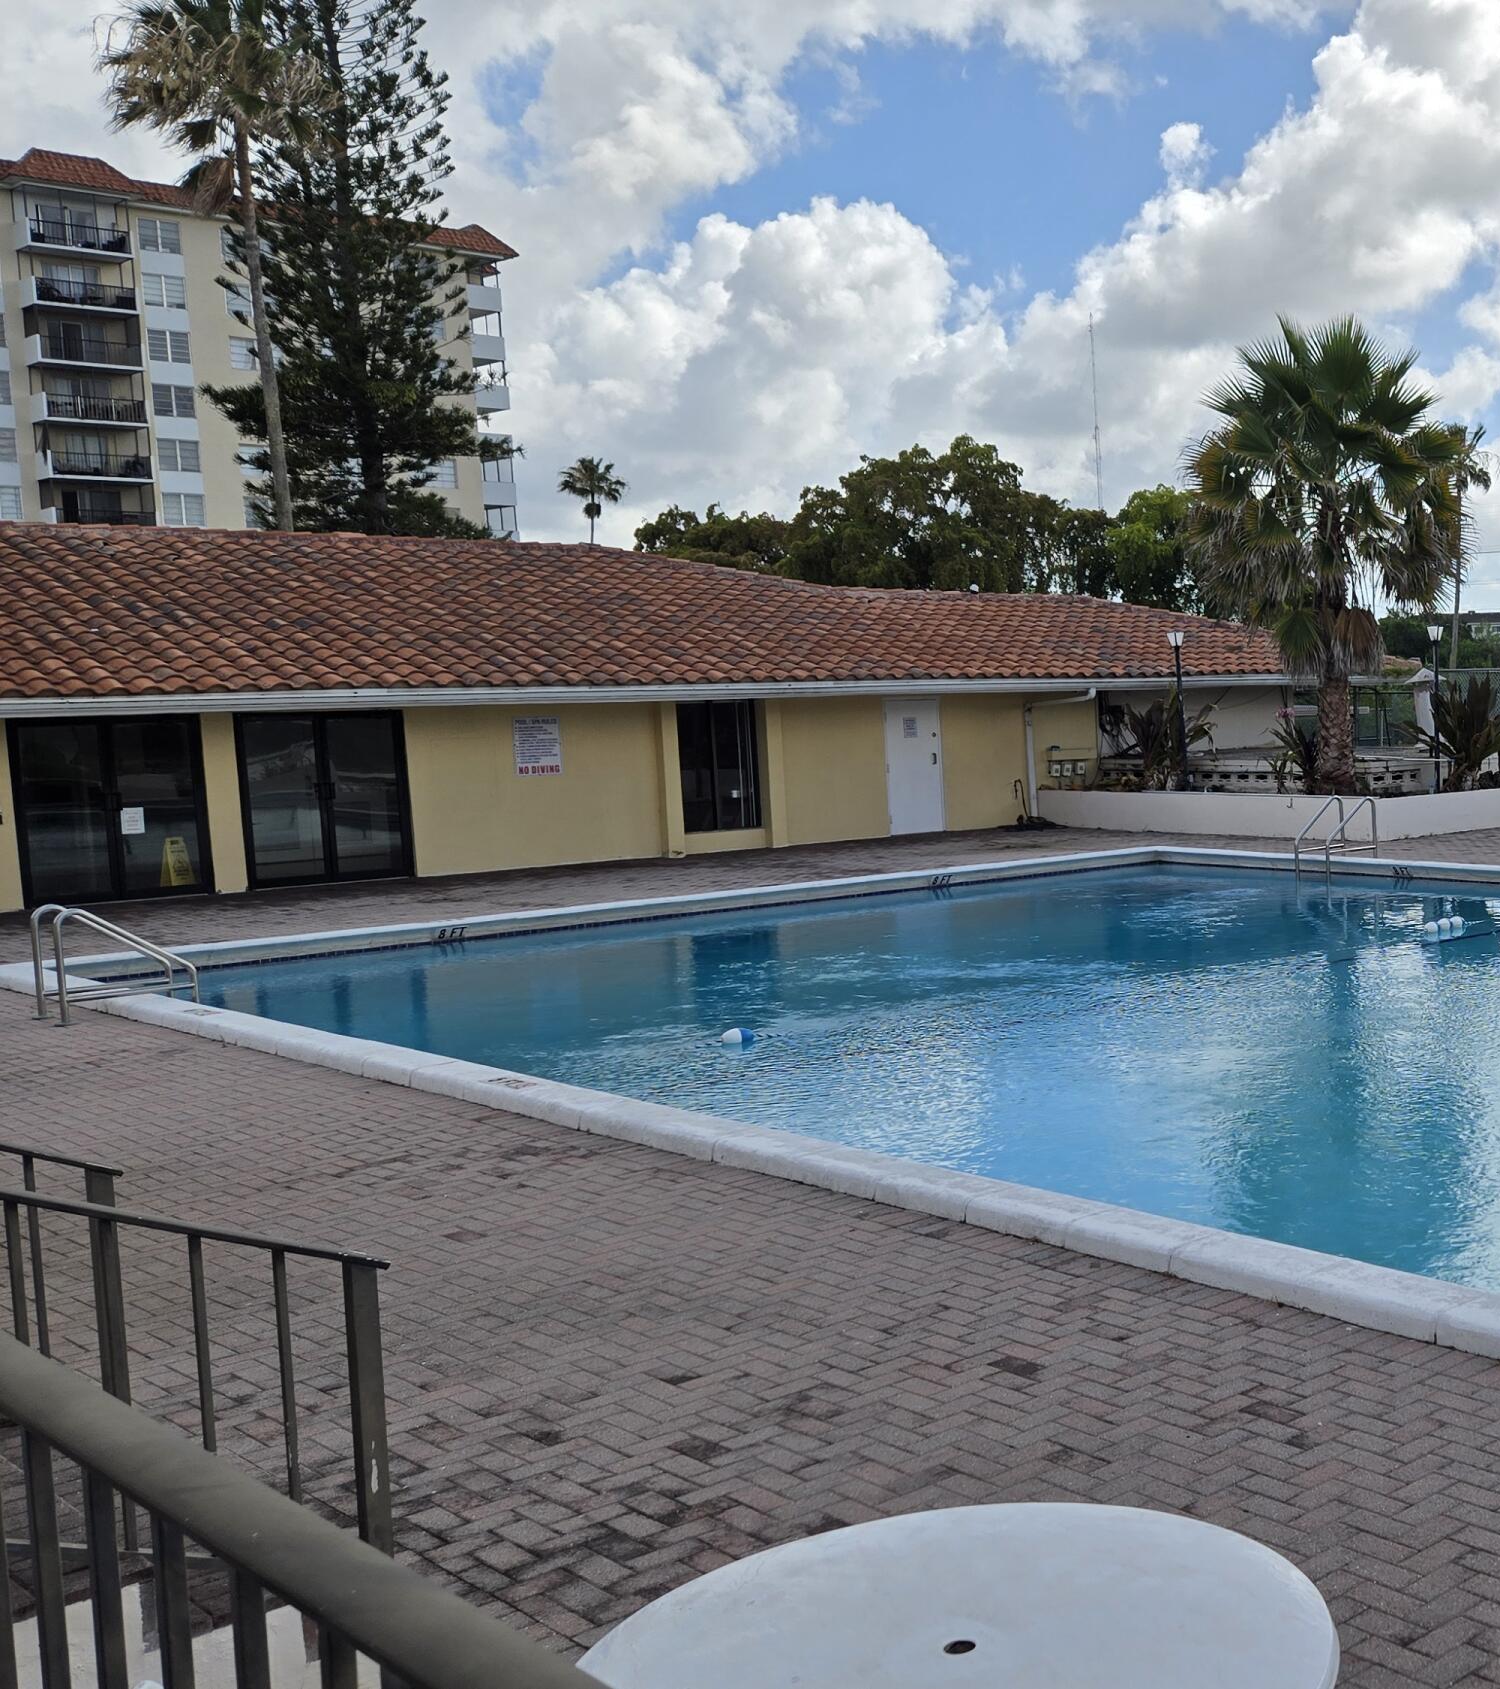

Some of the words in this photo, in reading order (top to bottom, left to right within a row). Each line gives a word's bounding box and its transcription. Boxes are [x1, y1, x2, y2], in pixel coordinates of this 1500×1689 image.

[518, 766, 530, 775] NO
[531, 764, 560, 774] DIVING
[940, 874, 953, 885] FT
[438, 928, 447, 939] 8
[450, 926, 468, 938] FT
